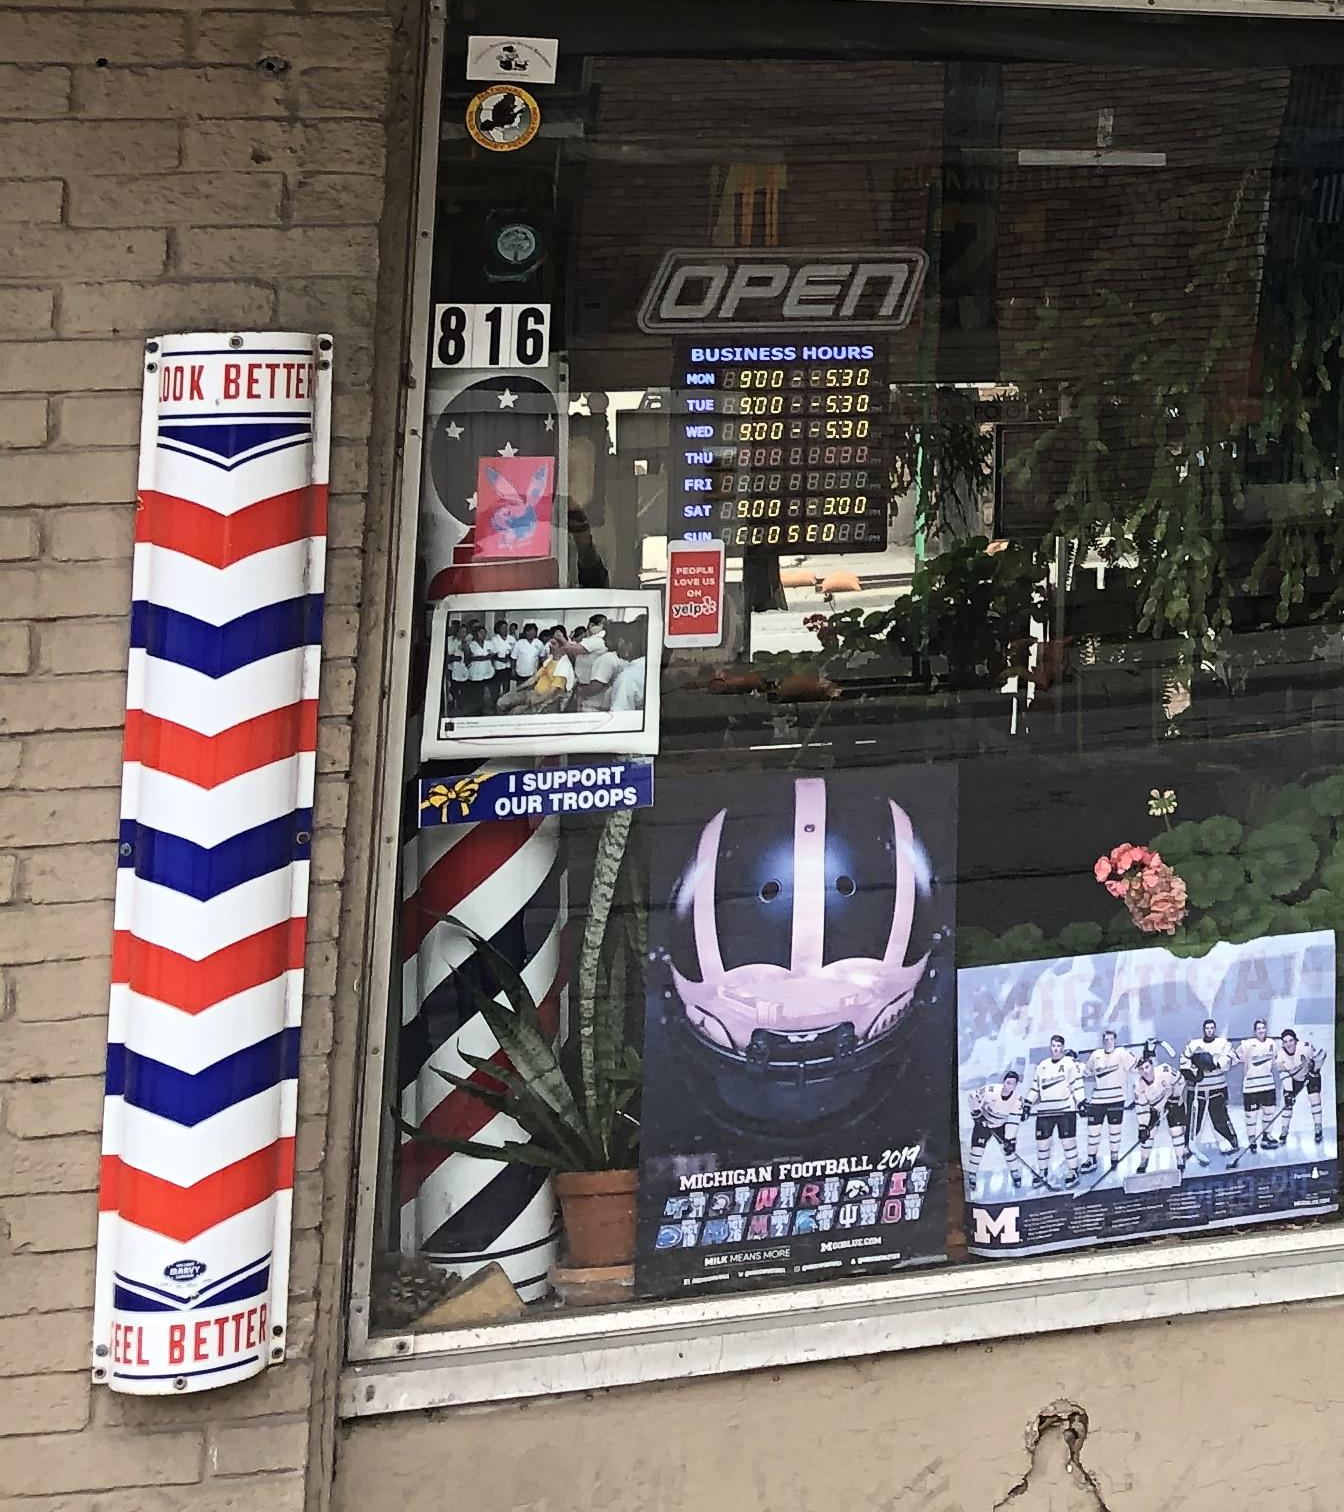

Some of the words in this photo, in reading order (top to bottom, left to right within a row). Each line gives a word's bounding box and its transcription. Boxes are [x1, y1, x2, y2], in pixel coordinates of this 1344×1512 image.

[660, 264, 908, 318] OPEN
[438, 306, 544, 366] 816
[691, 347, 797, 362] BUSINESS
[802, 345, 874, 360] HOURS
[159, 364, 204, 404] OOK
[686, 373, 715, 385] MON
[686, 399, 715, 412] TUE
[685, 426, 714, 438] WED
[684, 452, 714, 465] THU
[684, 479, 712, 491] FRI
[683, 505, 712, 518] SAT
[683, 531, 712, 541] SUN
[676, 566, 714, 575] PEOPLE
[674, 578, 700, 586] LOVE
[702, 577, 716, 585] US
[686, 589, 702, 598] ON
[672, 602, 702, 619] yelp
[508, 775, 516, 793] I
[522, 766, 625, 792] SUPPORT
[494, 795, 543, 817] OUR
[549, 787, 638, 813] TROOPS
[679, 1165, 772, 1192] MICHIGAN
[778, 1156, 873, 1180] FOOTBALL
[876, 1145, 921, 1170] 2019
[972, 1206, 1023, 1245] M
[704, 1256, 728, 1267] MILK
[729, 1253, 761, 1264] MEANS
[763, 1248, 790, 1259] MORE
[112, 1322, 150, 1366] EEL
[168, 1302, 268, 1365] BETTER
